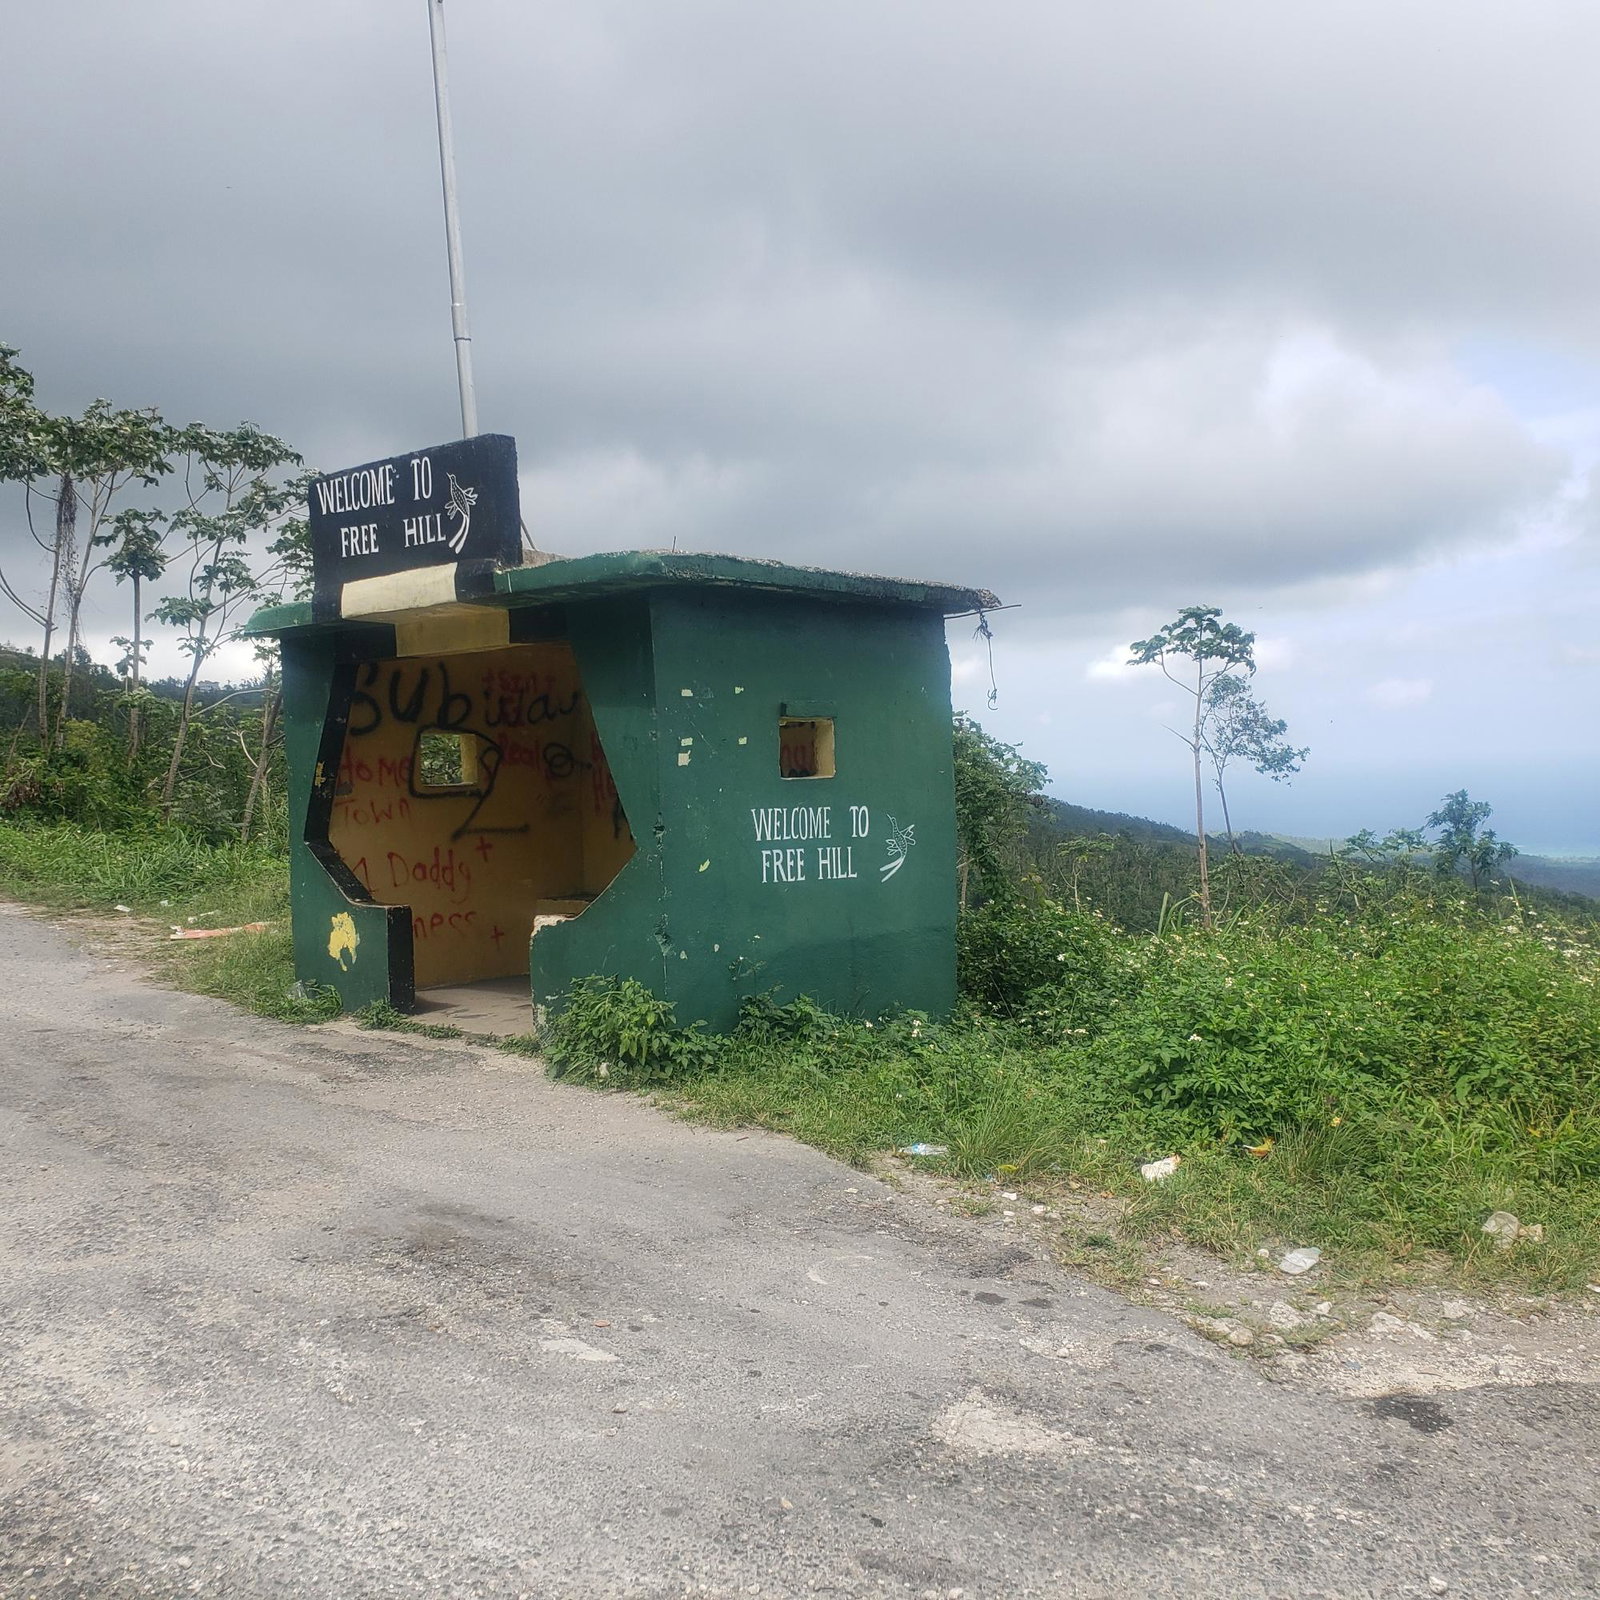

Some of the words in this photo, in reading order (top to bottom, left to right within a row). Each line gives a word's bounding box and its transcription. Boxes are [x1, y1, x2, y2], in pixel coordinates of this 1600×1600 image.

[316, 464, 395, 515] WELCOME
[410, 456, 433, 501] TO
[340, 523, 380, 558] FREE
[403, 513, 446, 548] HILL
[751, 806, 831, 841] WELCOME
[849, 805, 870, 838] TO
[761, 848, 806, 883] FREE
[817, 846, 858, 880] HILL
